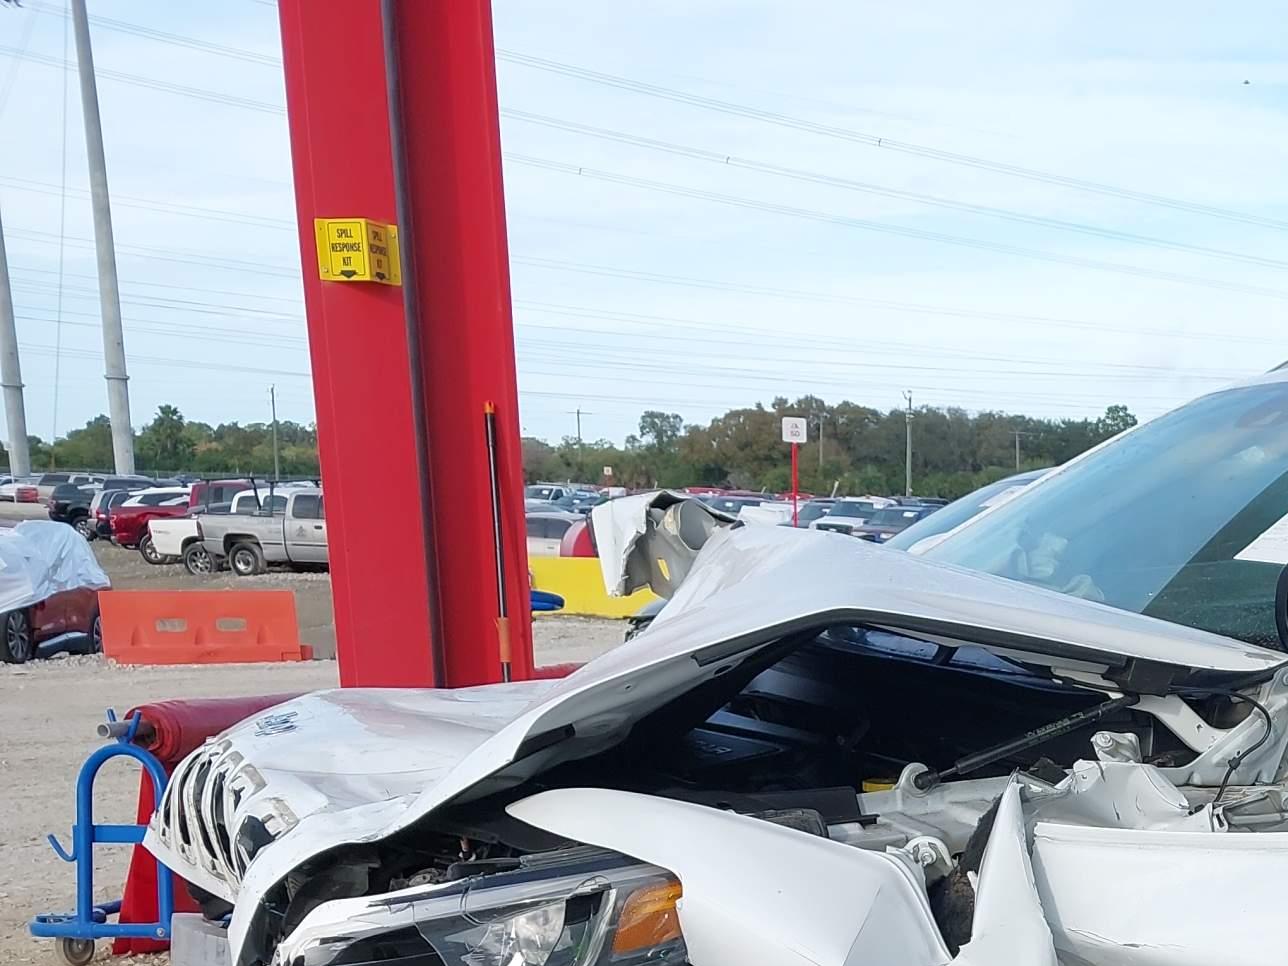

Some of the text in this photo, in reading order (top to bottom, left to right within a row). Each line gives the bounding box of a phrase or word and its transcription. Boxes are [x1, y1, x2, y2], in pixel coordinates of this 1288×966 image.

[336, 228, 353, 238] SPILL
[331, 242, 361, 252] RESPONSE
[342, 256, 352, 266] KIT
